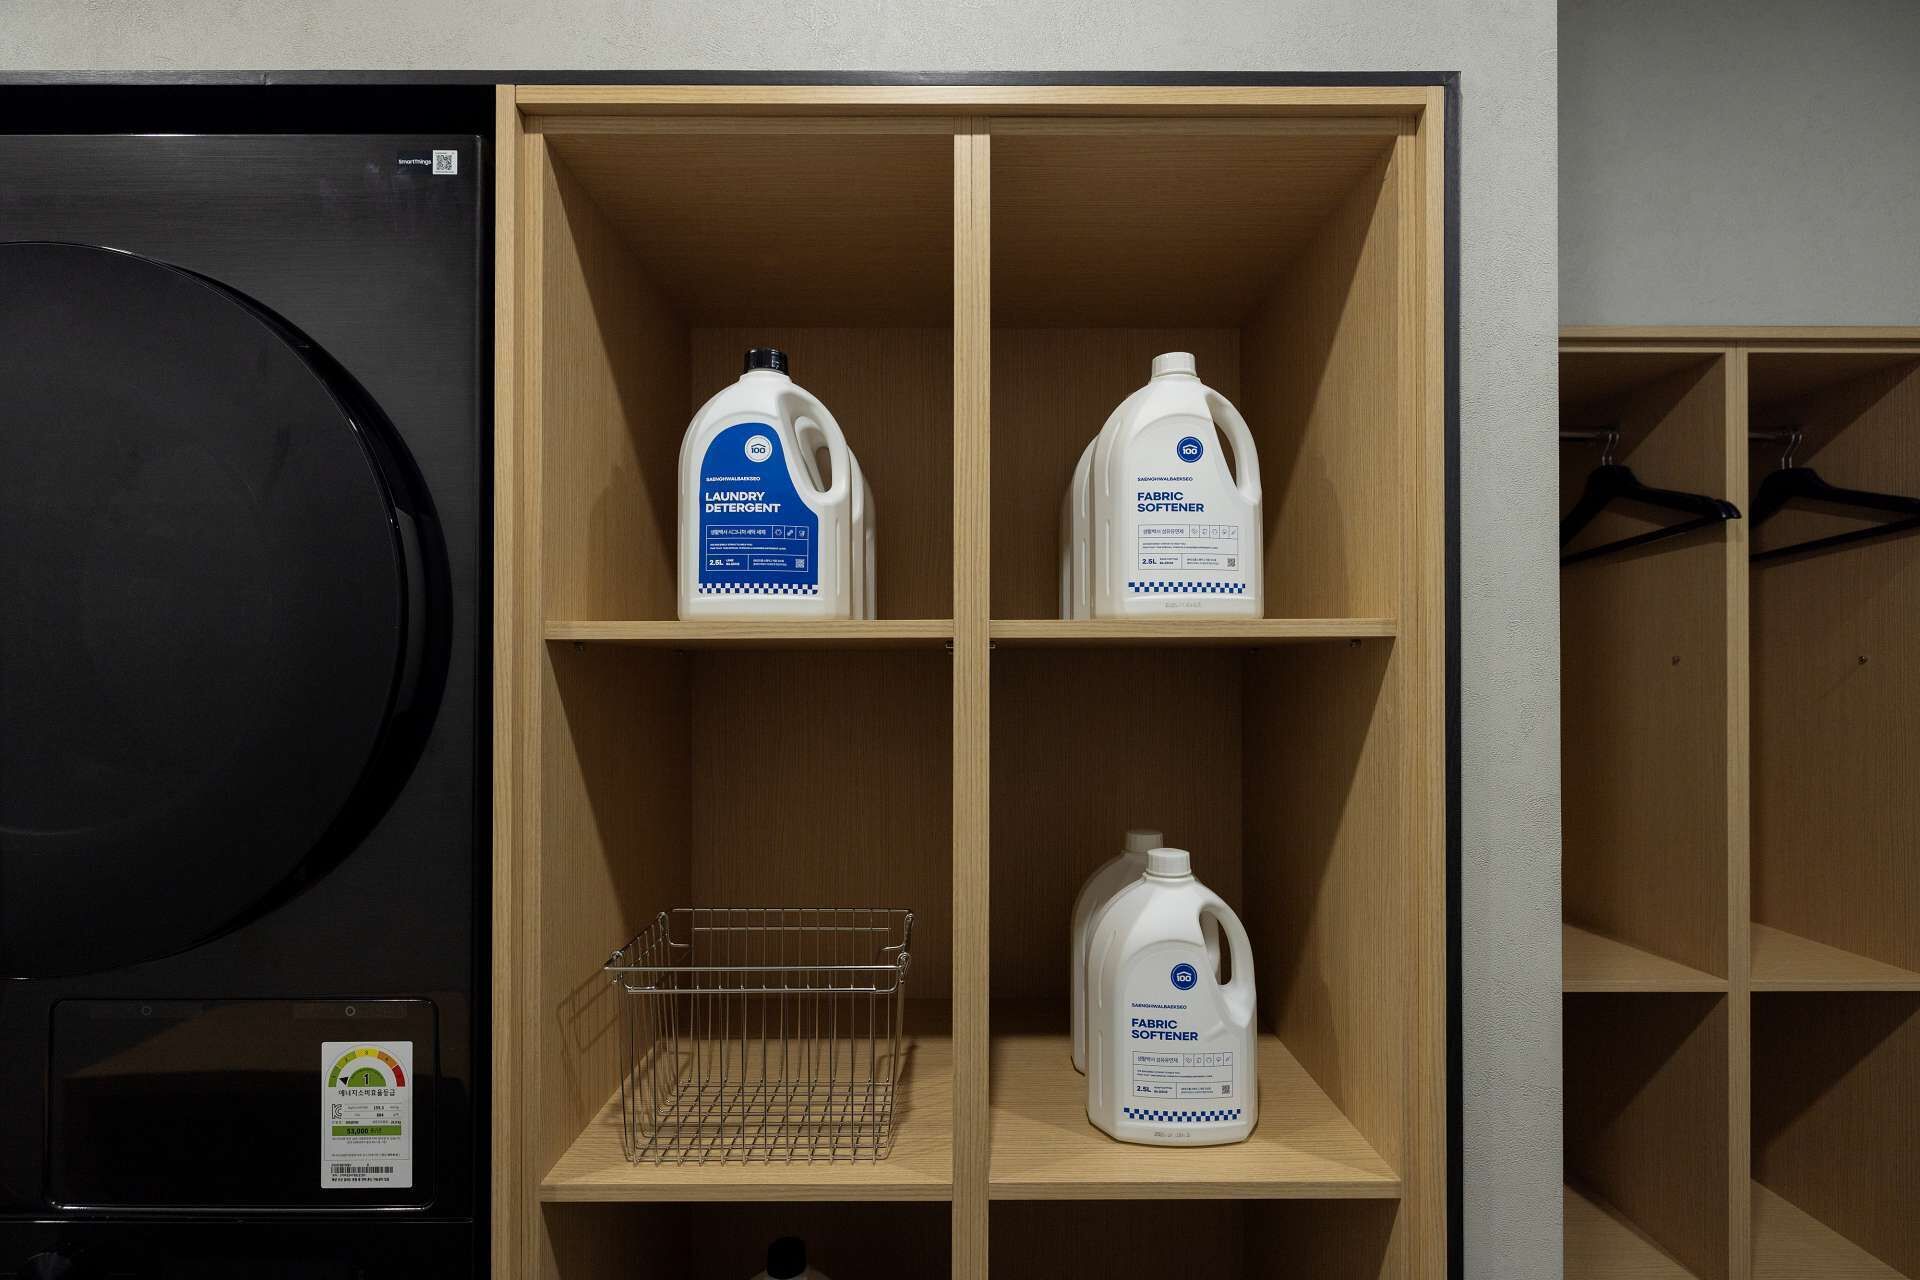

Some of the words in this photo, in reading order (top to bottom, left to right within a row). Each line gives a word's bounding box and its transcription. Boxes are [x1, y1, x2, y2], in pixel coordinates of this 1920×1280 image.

[706, 492, 765, 501] LAUNDRY
[1138, 492, 1183, 501] FABRIC
[706, 504, 780, 512] DETERGENT
[1138, 503, 1204, 512] SOFTENER
[1132, 1018, 1177, 1029] FABRIC
[1132, 1030, 1198, 1040] SOFTENER
[364, 1073, 369, 1085] 1
